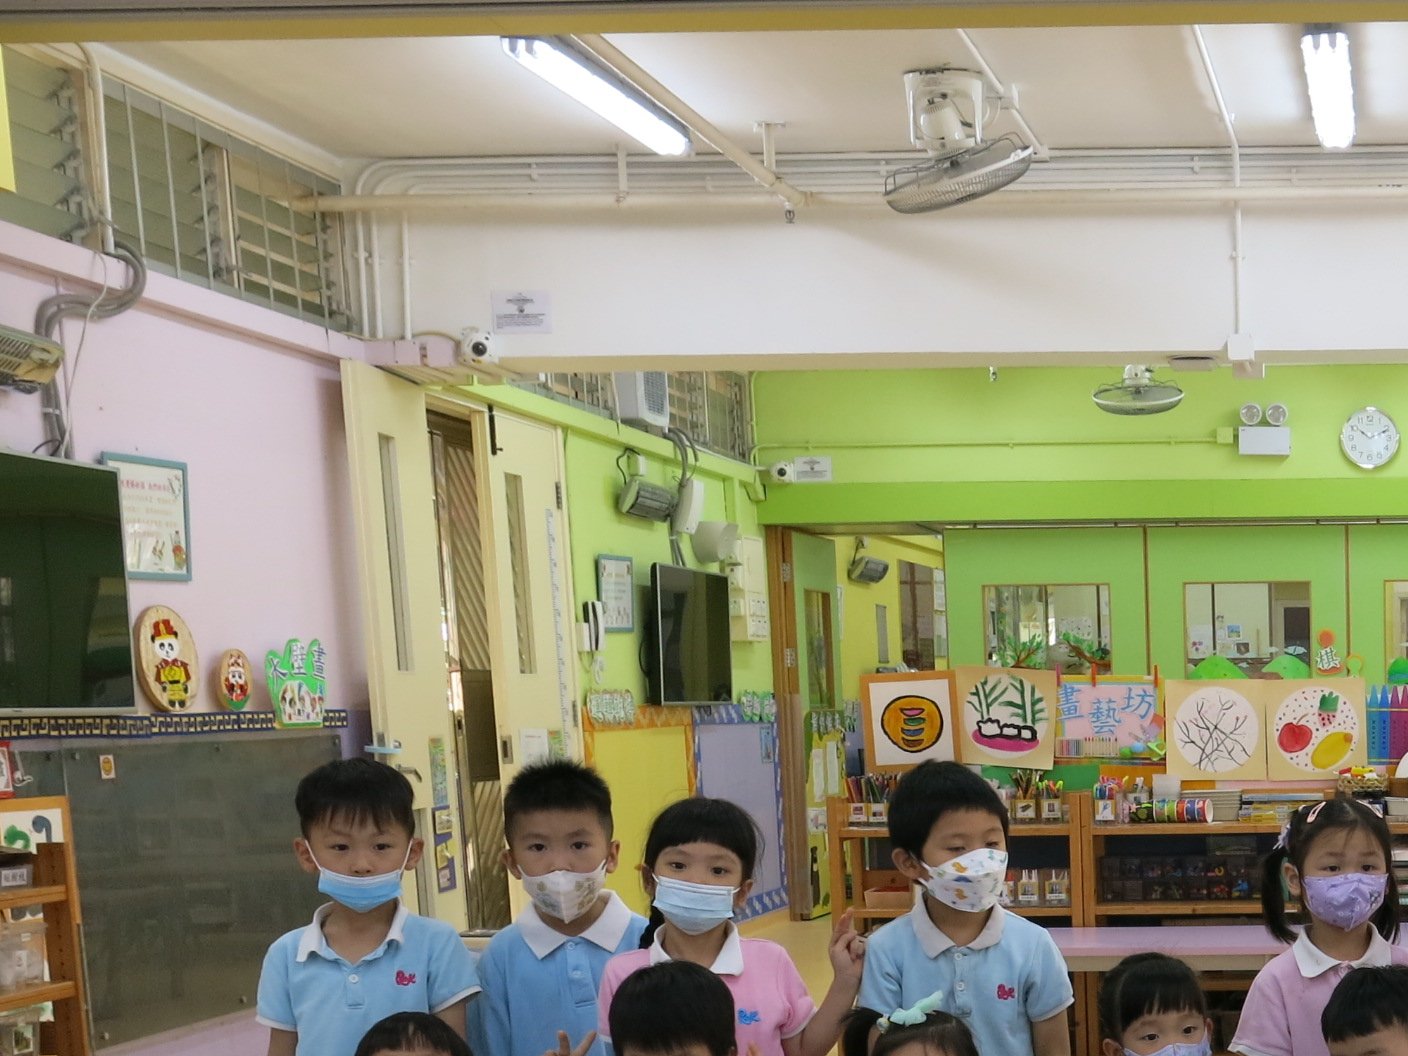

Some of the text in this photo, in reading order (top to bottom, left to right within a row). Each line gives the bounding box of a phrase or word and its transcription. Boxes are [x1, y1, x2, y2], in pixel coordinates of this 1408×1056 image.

[1318, 647, 1339, 669] 棋
[1057, 684, 1155, 735] 畫藝坊
